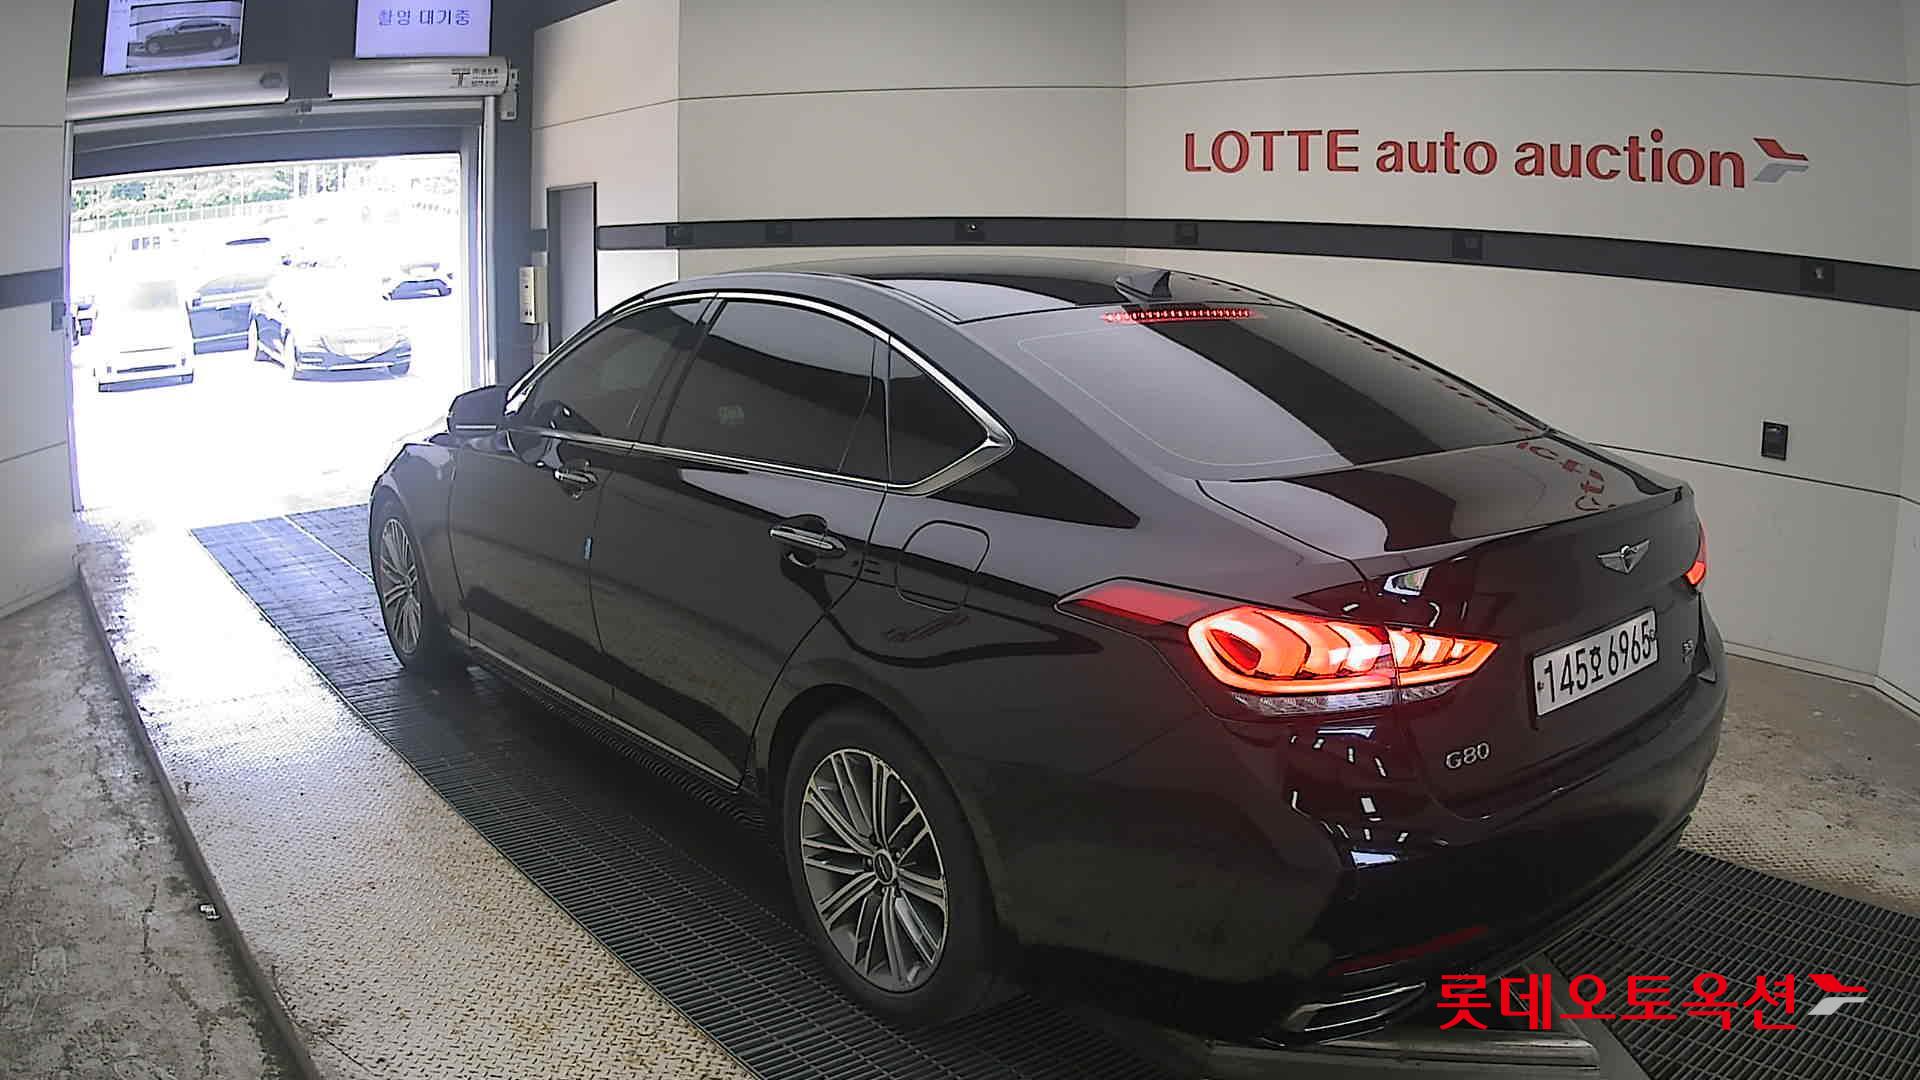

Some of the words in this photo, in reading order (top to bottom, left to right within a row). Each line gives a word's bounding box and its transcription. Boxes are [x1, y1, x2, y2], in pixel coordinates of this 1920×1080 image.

[419, 9, 470, 26] 대기중
[1185, 129, 1358, 173] LOTTE
[1376, 132, 1498, 174] auto
[1515, 129, 1745, 188] auction
[1608, 620, 1651, 676] 6965
[1446, 742, 1489, 769] G80
